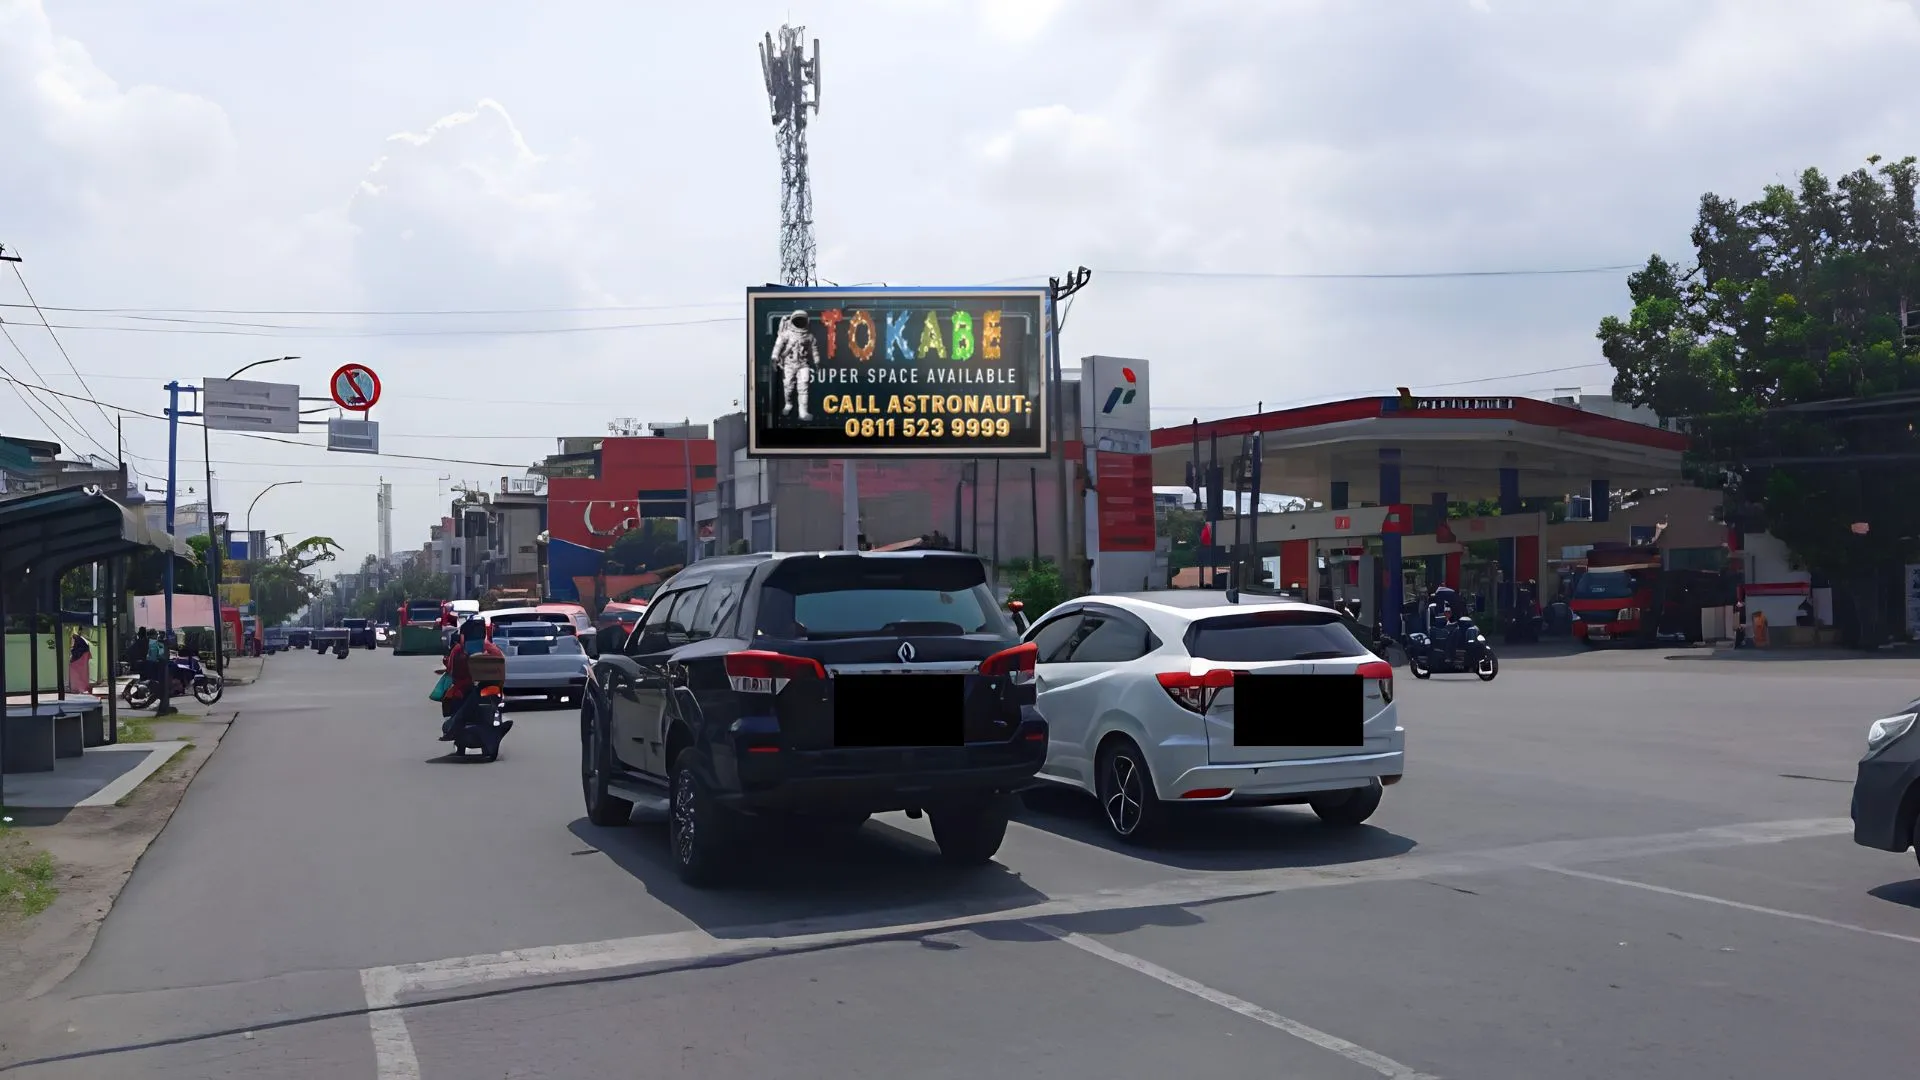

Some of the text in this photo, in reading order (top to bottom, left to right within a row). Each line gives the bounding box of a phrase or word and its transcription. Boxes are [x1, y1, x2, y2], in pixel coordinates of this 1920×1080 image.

[819, 308, 1002, 361] TOKABE
[808, 368, 1016, 384] SUPER SPACE AVAILABLE
[823, 394, 1032, 414] CALL ASTRONAUT:
[845, 418, 1010, 438] 0811 523 9999
